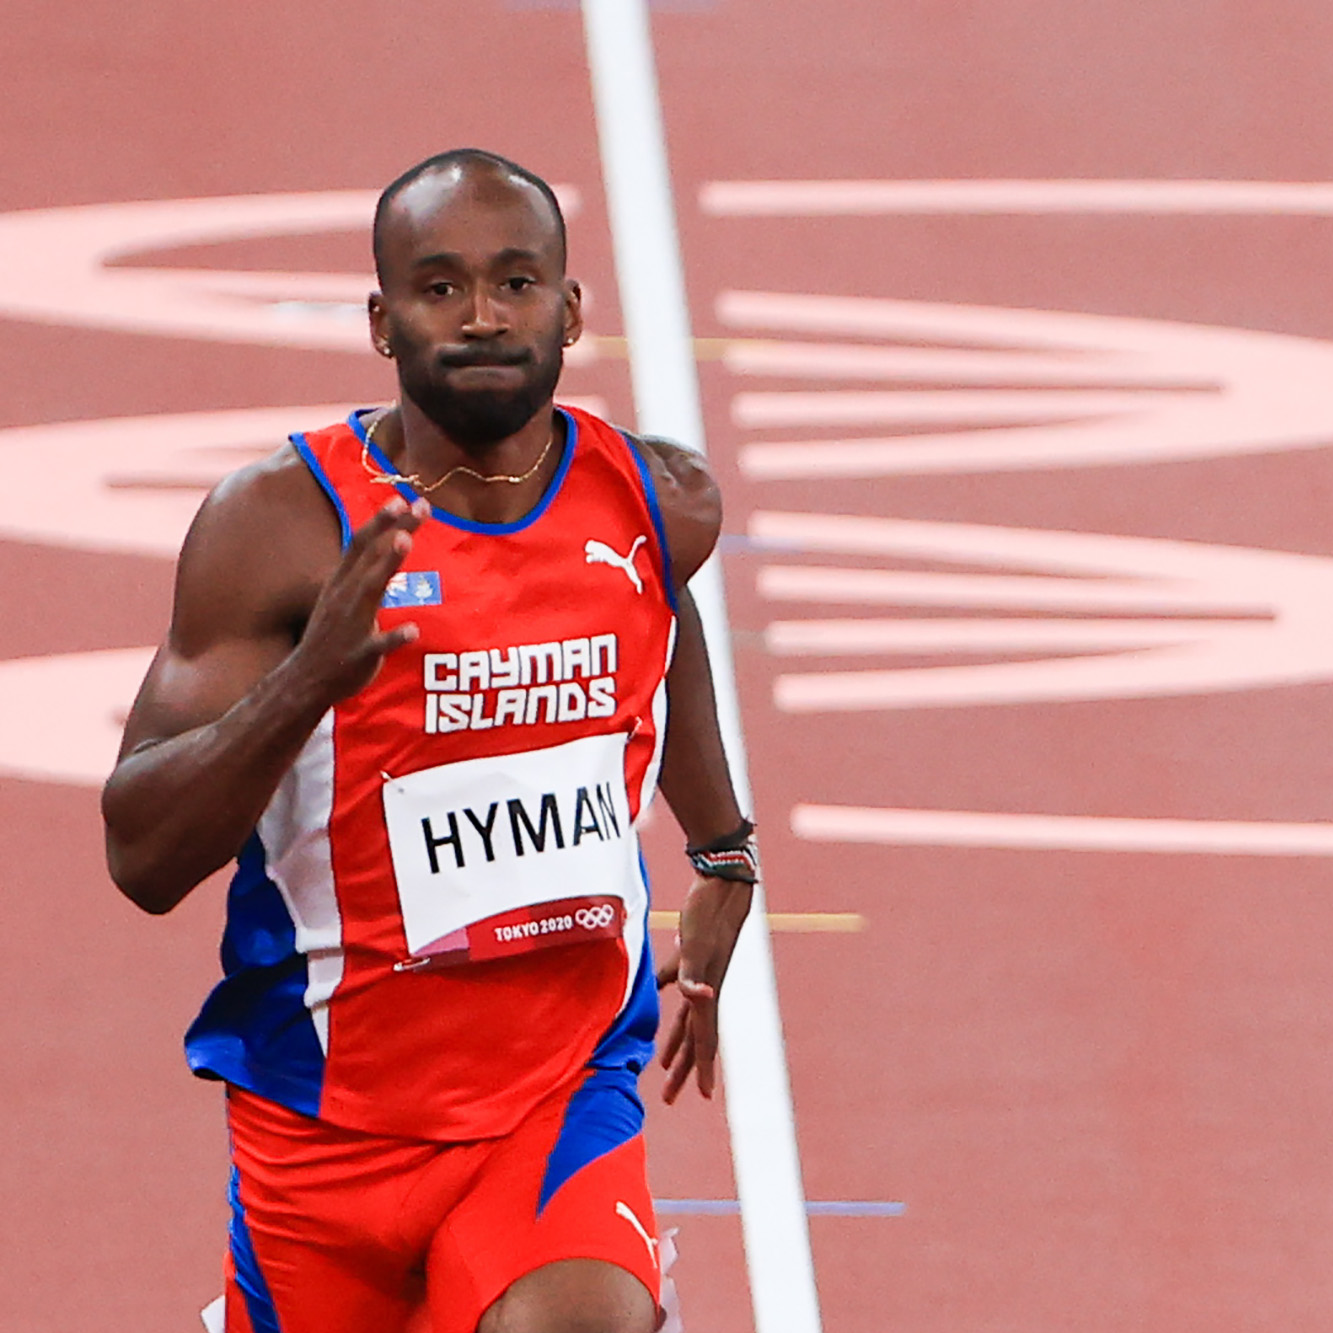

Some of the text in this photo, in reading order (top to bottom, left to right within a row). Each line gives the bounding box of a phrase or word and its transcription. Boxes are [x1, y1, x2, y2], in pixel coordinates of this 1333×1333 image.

[423, 633, 618, 692] CAYMAN
[424, 676, 617, 735] ISLANDS
[420, 781, 621, 875] HYMAN
[494, 914, 574, 943] TOKYO 2020
